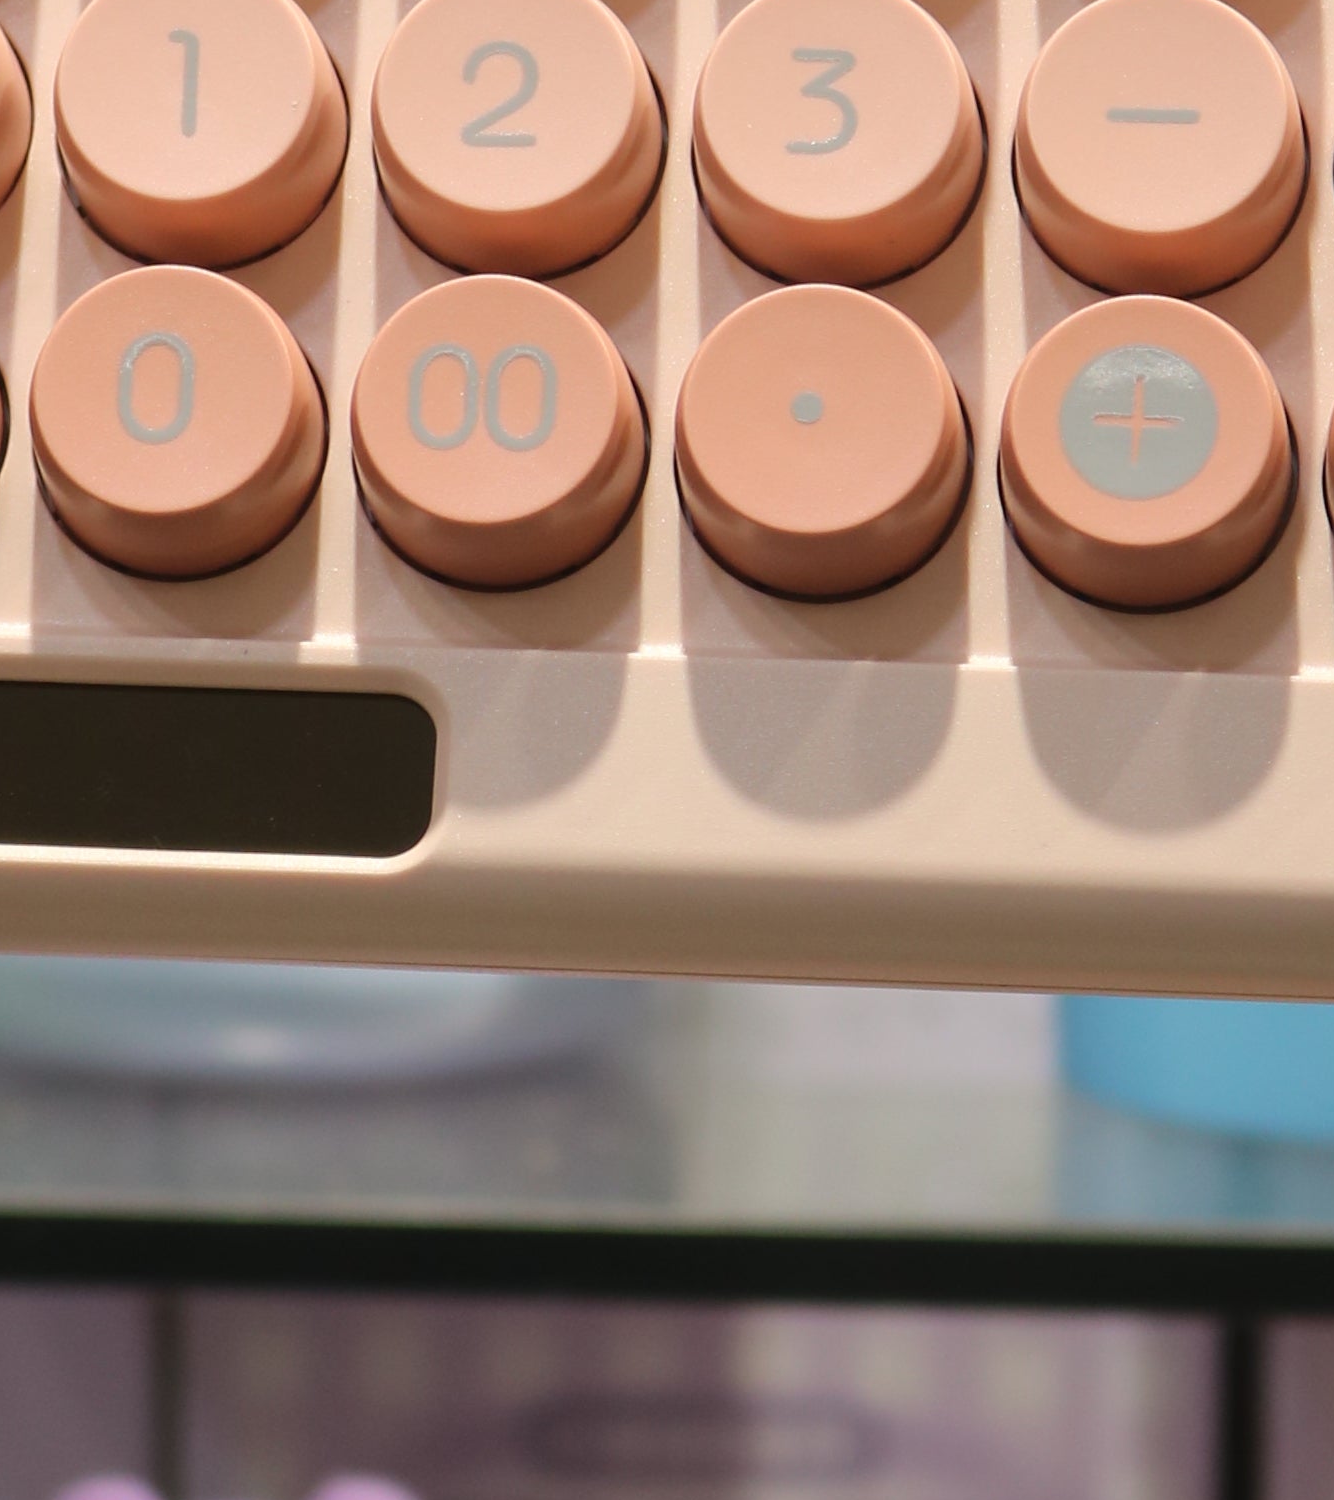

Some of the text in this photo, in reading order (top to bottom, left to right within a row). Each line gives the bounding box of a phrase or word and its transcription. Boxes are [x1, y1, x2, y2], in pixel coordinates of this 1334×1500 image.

[167, 28, 202, 139] 1
[458, 39, 540, 149] 2
[785, 48, 859, 156] 3
[116, 331, 195, 446] 0
[406, 342, 559, 452] 00
